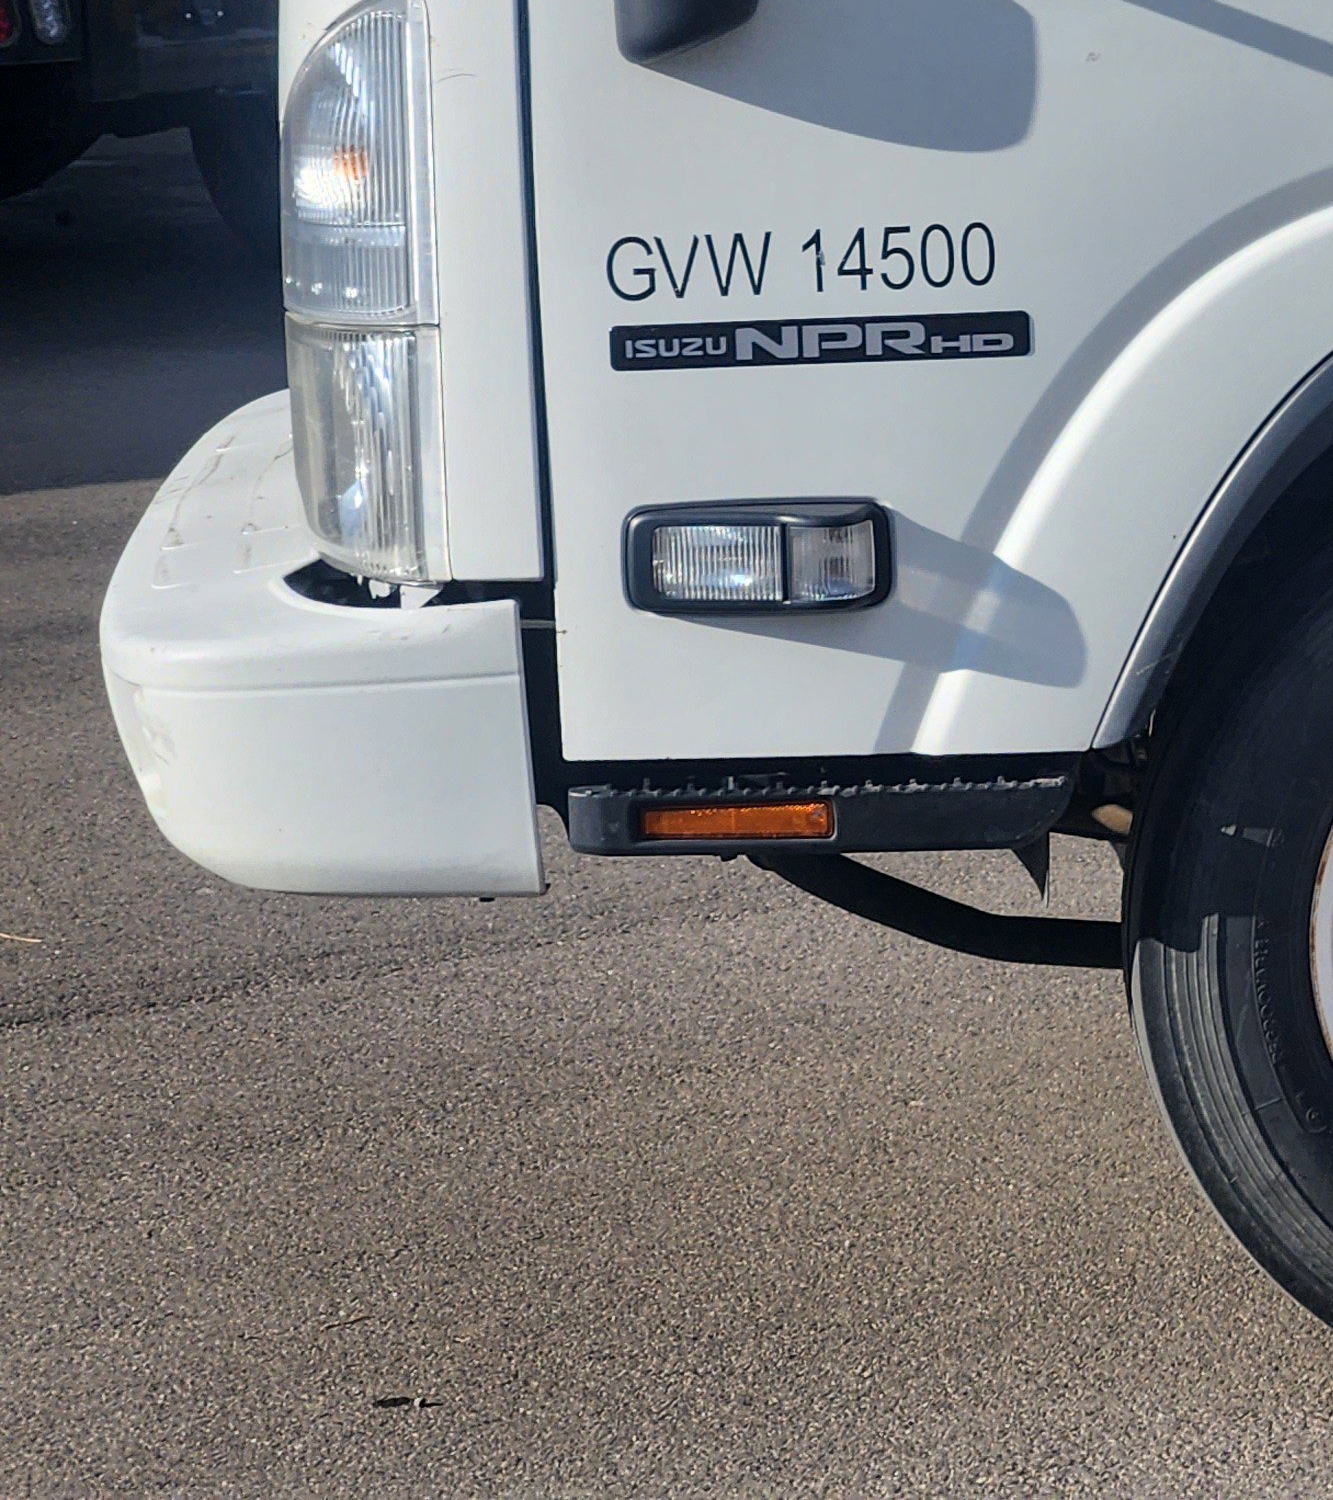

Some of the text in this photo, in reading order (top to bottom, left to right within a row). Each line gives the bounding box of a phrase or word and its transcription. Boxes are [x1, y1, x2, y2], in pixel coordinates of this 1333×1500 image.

[606, 222, 996, 301] GVW 14500
[625, 335, 727, 359] ISUZU
